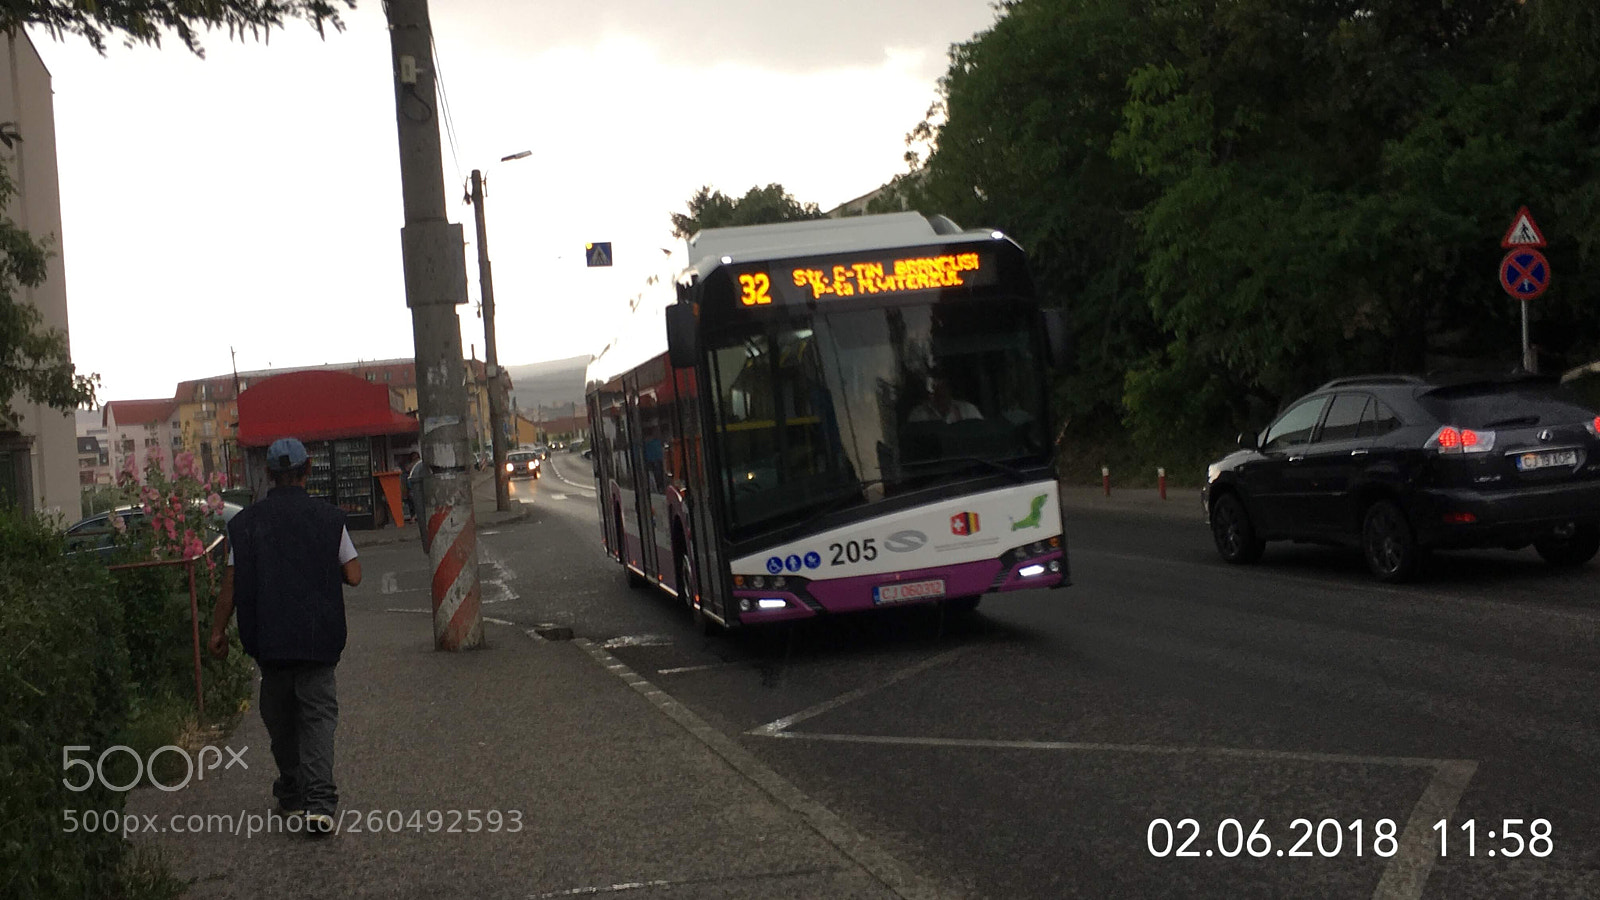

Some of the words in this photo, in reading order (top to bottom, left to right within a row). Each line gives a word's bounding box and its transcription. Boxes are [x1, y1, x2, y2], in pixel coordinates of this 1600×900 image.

[833, 263, 884, 282] C-TIN
[738, 272, 772, 305] 32
[829, 539, 877, 566] 205
[882, 587, 898, 600] CJ
